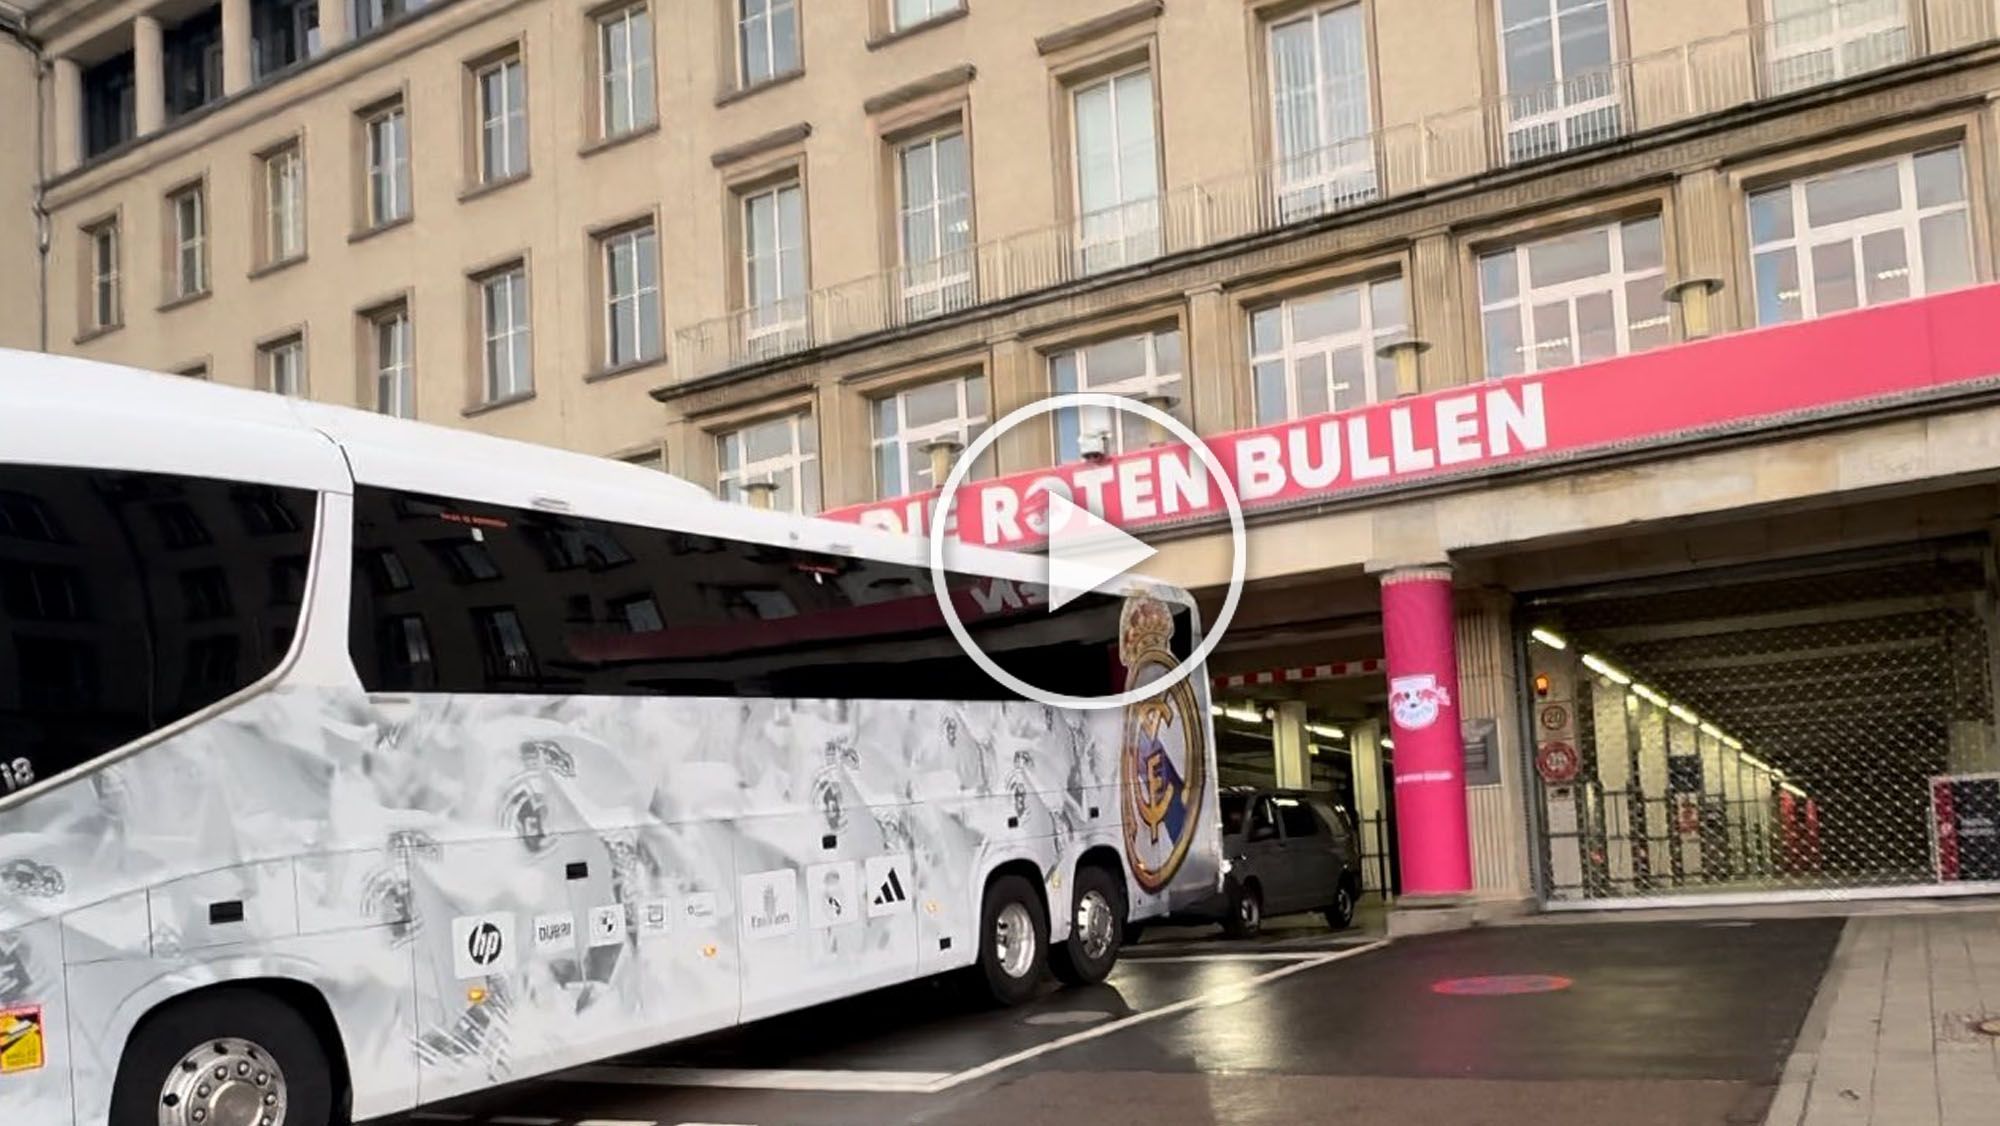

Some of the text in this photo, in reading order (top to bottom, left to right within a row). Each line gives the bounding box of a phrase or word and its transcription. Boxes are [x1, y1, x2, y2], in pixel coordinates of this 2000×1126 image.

[981, 449, 1210, 545] ROTEN
[1236, 382, 1547, 501] BULLEN
[472, 921, 502, 965] hp
